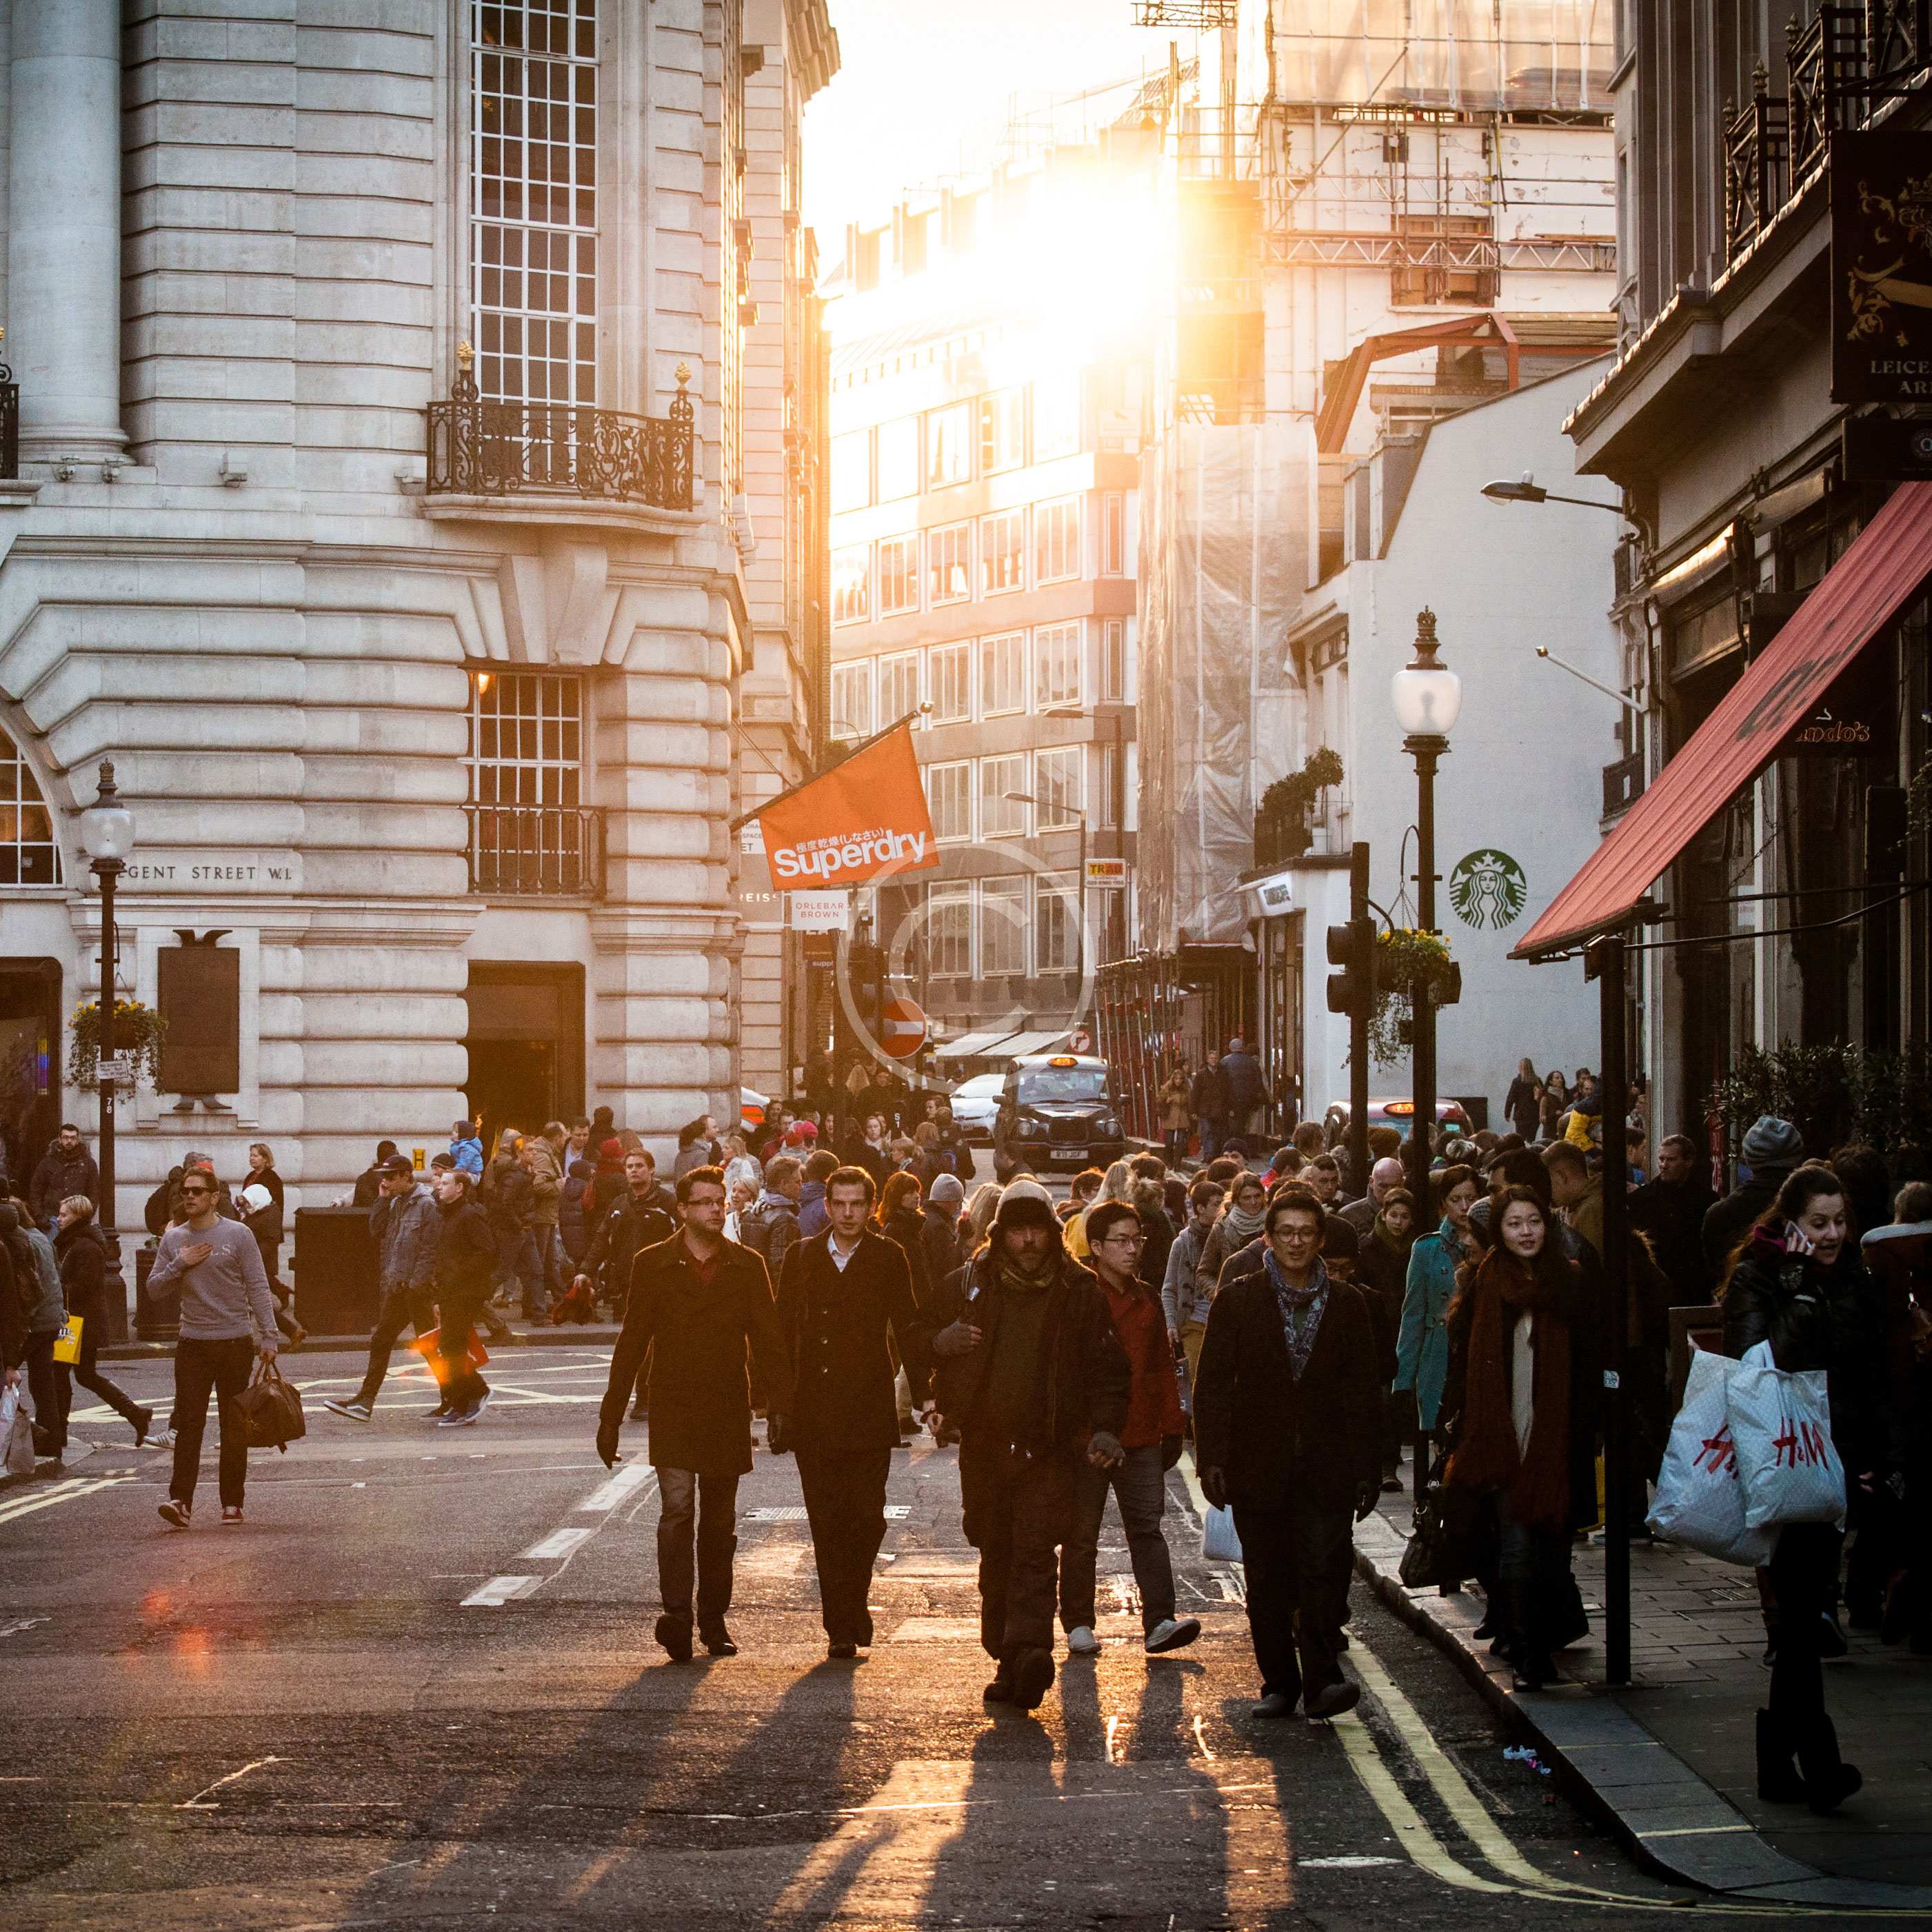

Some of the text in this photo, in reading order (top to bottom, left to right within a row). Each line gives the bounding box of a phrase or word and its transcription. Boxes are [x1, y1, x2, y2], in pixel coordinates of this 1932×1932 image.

[1871, 360, 1932, 374] LEICE
[1900, 380, 1932, 394] AR
[741, 843, 754, 852] ET
[774, 829, 926, 879] Superdry
[118, 865, 176, 879] GENT
[192, 866, 256, 880] STREET
[795, 902, 845, 910] ORLEBAR
[1771, 1416, 1829, 1471] H&M
[1693, 1423, 1740, 1480] H&
